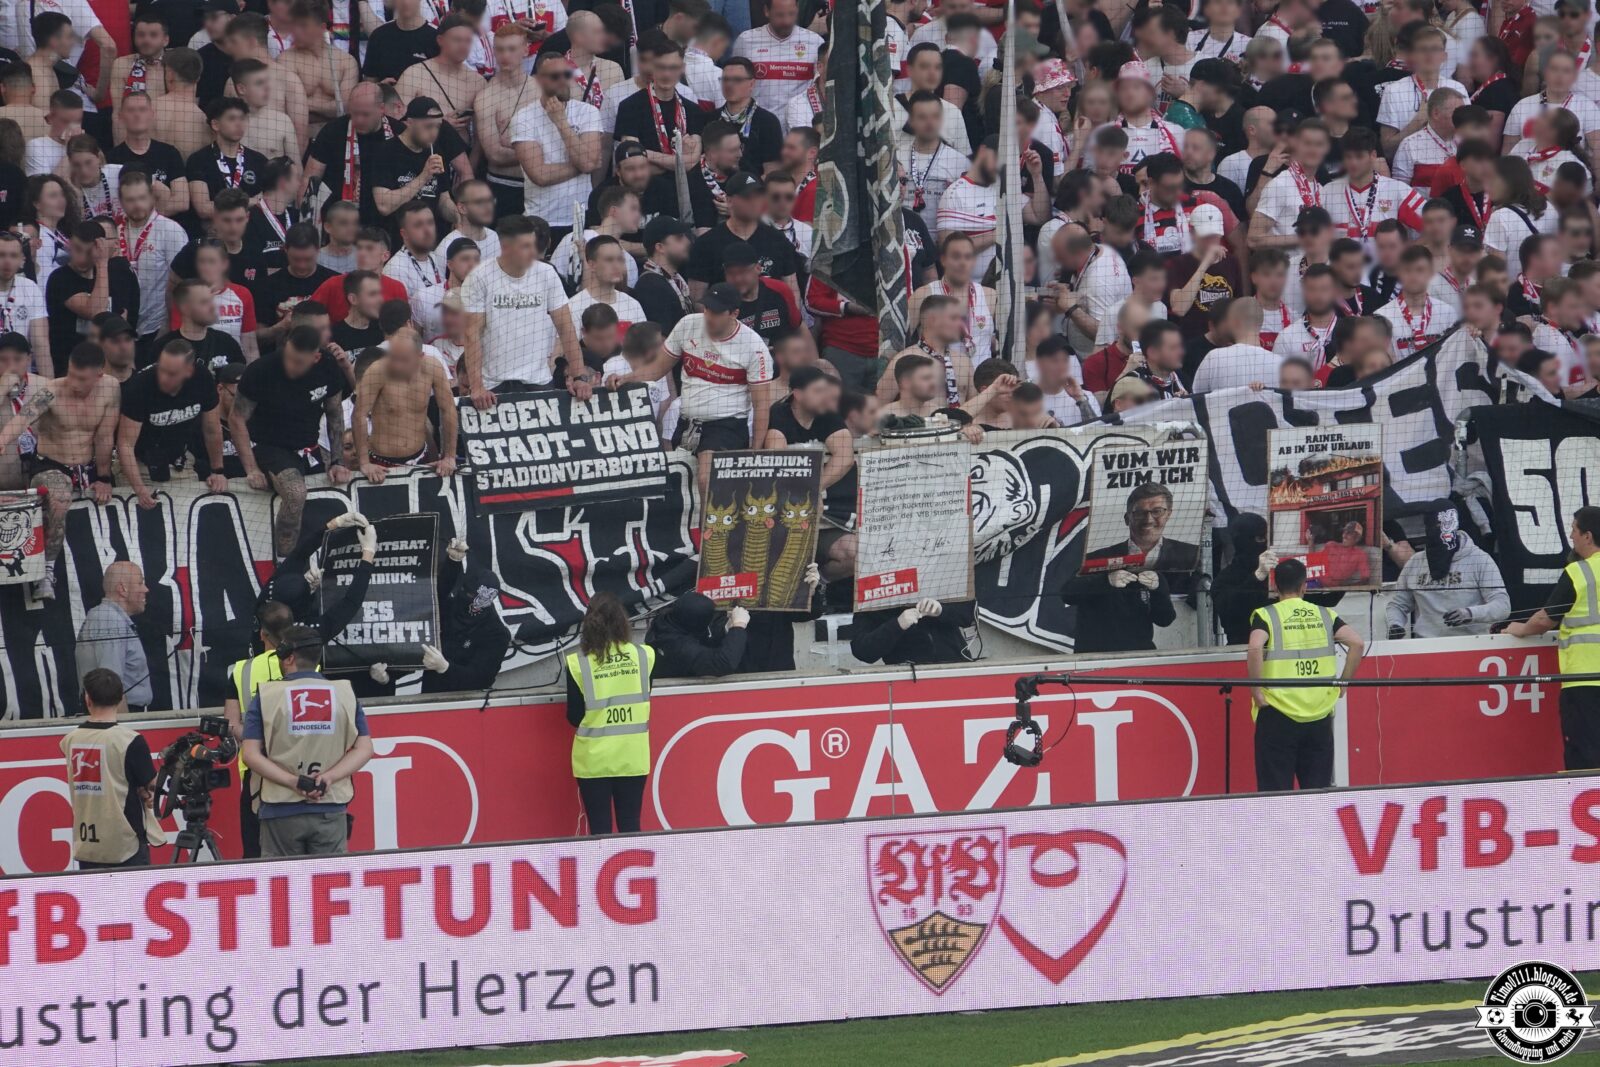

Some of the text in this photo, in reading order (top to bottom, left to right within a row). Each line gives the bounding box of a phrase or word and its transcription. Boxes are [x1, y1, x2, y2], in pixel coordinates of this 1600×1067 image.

[461, 388, 651, 433] GEGEN ALLE
[467, 421, 660, 465] STADT- UND
[1305, 433, 1346, 444] RAINER:
[1278, 440, 1374, 455] AB IN DEN URLAUB!
[879, 456, 900, 464] einzige
[901, 451, 958, 460] Absichtserklärung
[1102, 447, 1200, 470] VOM WIR
[476, 452, 667, 490] STADIONVERBOTE!
[717, 468, 812, 479] RÜCKTRITT JETZT!
[1107, 466, 1194, 489] ZUM ICH
[893, 493, 920, 501] erklären
[937, 489, 965, 497] unseren
[864, 504, 899, 514] sofortigen
[902, 501, 933, 509] Rücktritt
[865, 514, 898, 523] Präsidium
[933, 507, 964, 516] Stuttgart
[865, 524, 881, 533] 1893
[328, 540, 430, 557] AUFSHTSRAT,
[333, 555, 422, 569] INVTOREN,
[336, 572, 417, 586] PRIDIUM:
[720, 575, 736, 587] ES
[880, 572, 896, 586] ES
[863, 581, 914, 601] REICHT!
[362, 600, 395, 623] ES
[1293, 608, 1315, 618] SDS
[606, 652, 631, 664] SDS
[1295, 660, 1320, 676] 1992
[1478, 653, 1545, 717] 34
[606, 706, 633, 724] 2001
[79, 822, 100, 843] 01
[903, 903, 974, 920] 18 93
[273, 968, 380, 1029] der
[419, 959, 660, 1019] Herzen
